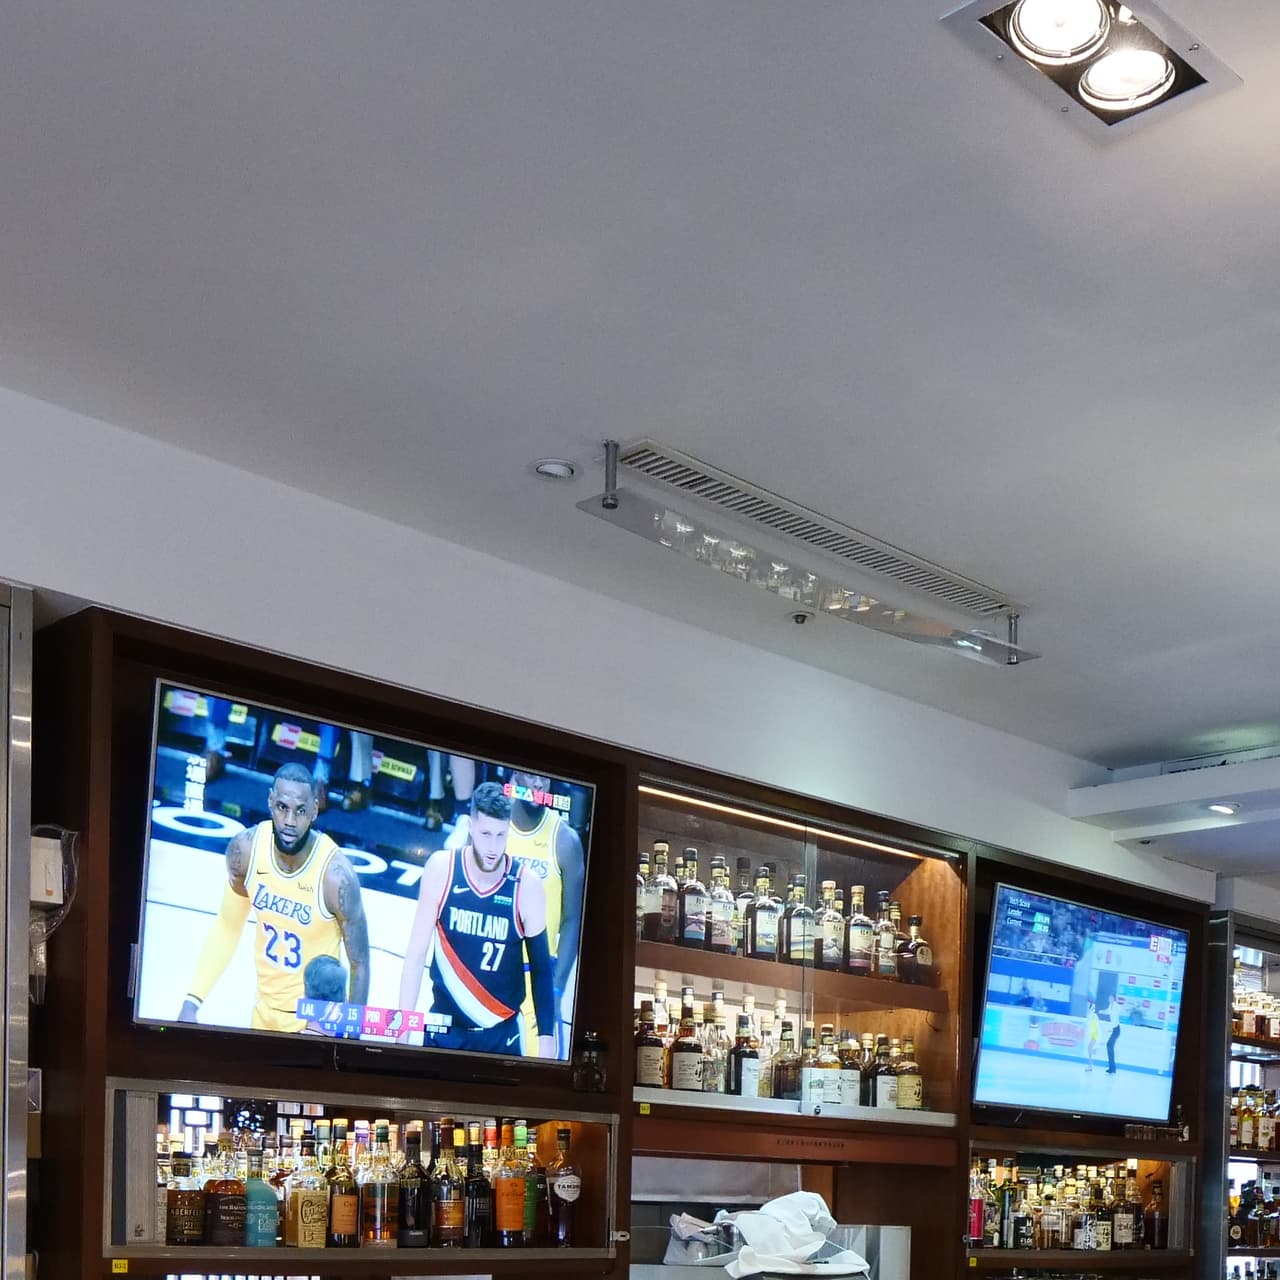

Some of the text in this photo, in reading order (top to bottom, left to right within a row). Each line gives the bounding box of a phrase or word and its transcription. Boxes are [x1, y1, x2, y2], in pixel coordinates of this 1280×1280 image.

[251, 883, 313, 926] LAKERS
[449, 906, 509, 941] PORTLAND
[262, 921, 302, 969] 23
[479, 940, 506, 972] 27
[347, 1007, 358, 1021] 15
[407, 1015, 419, 1028] 22
